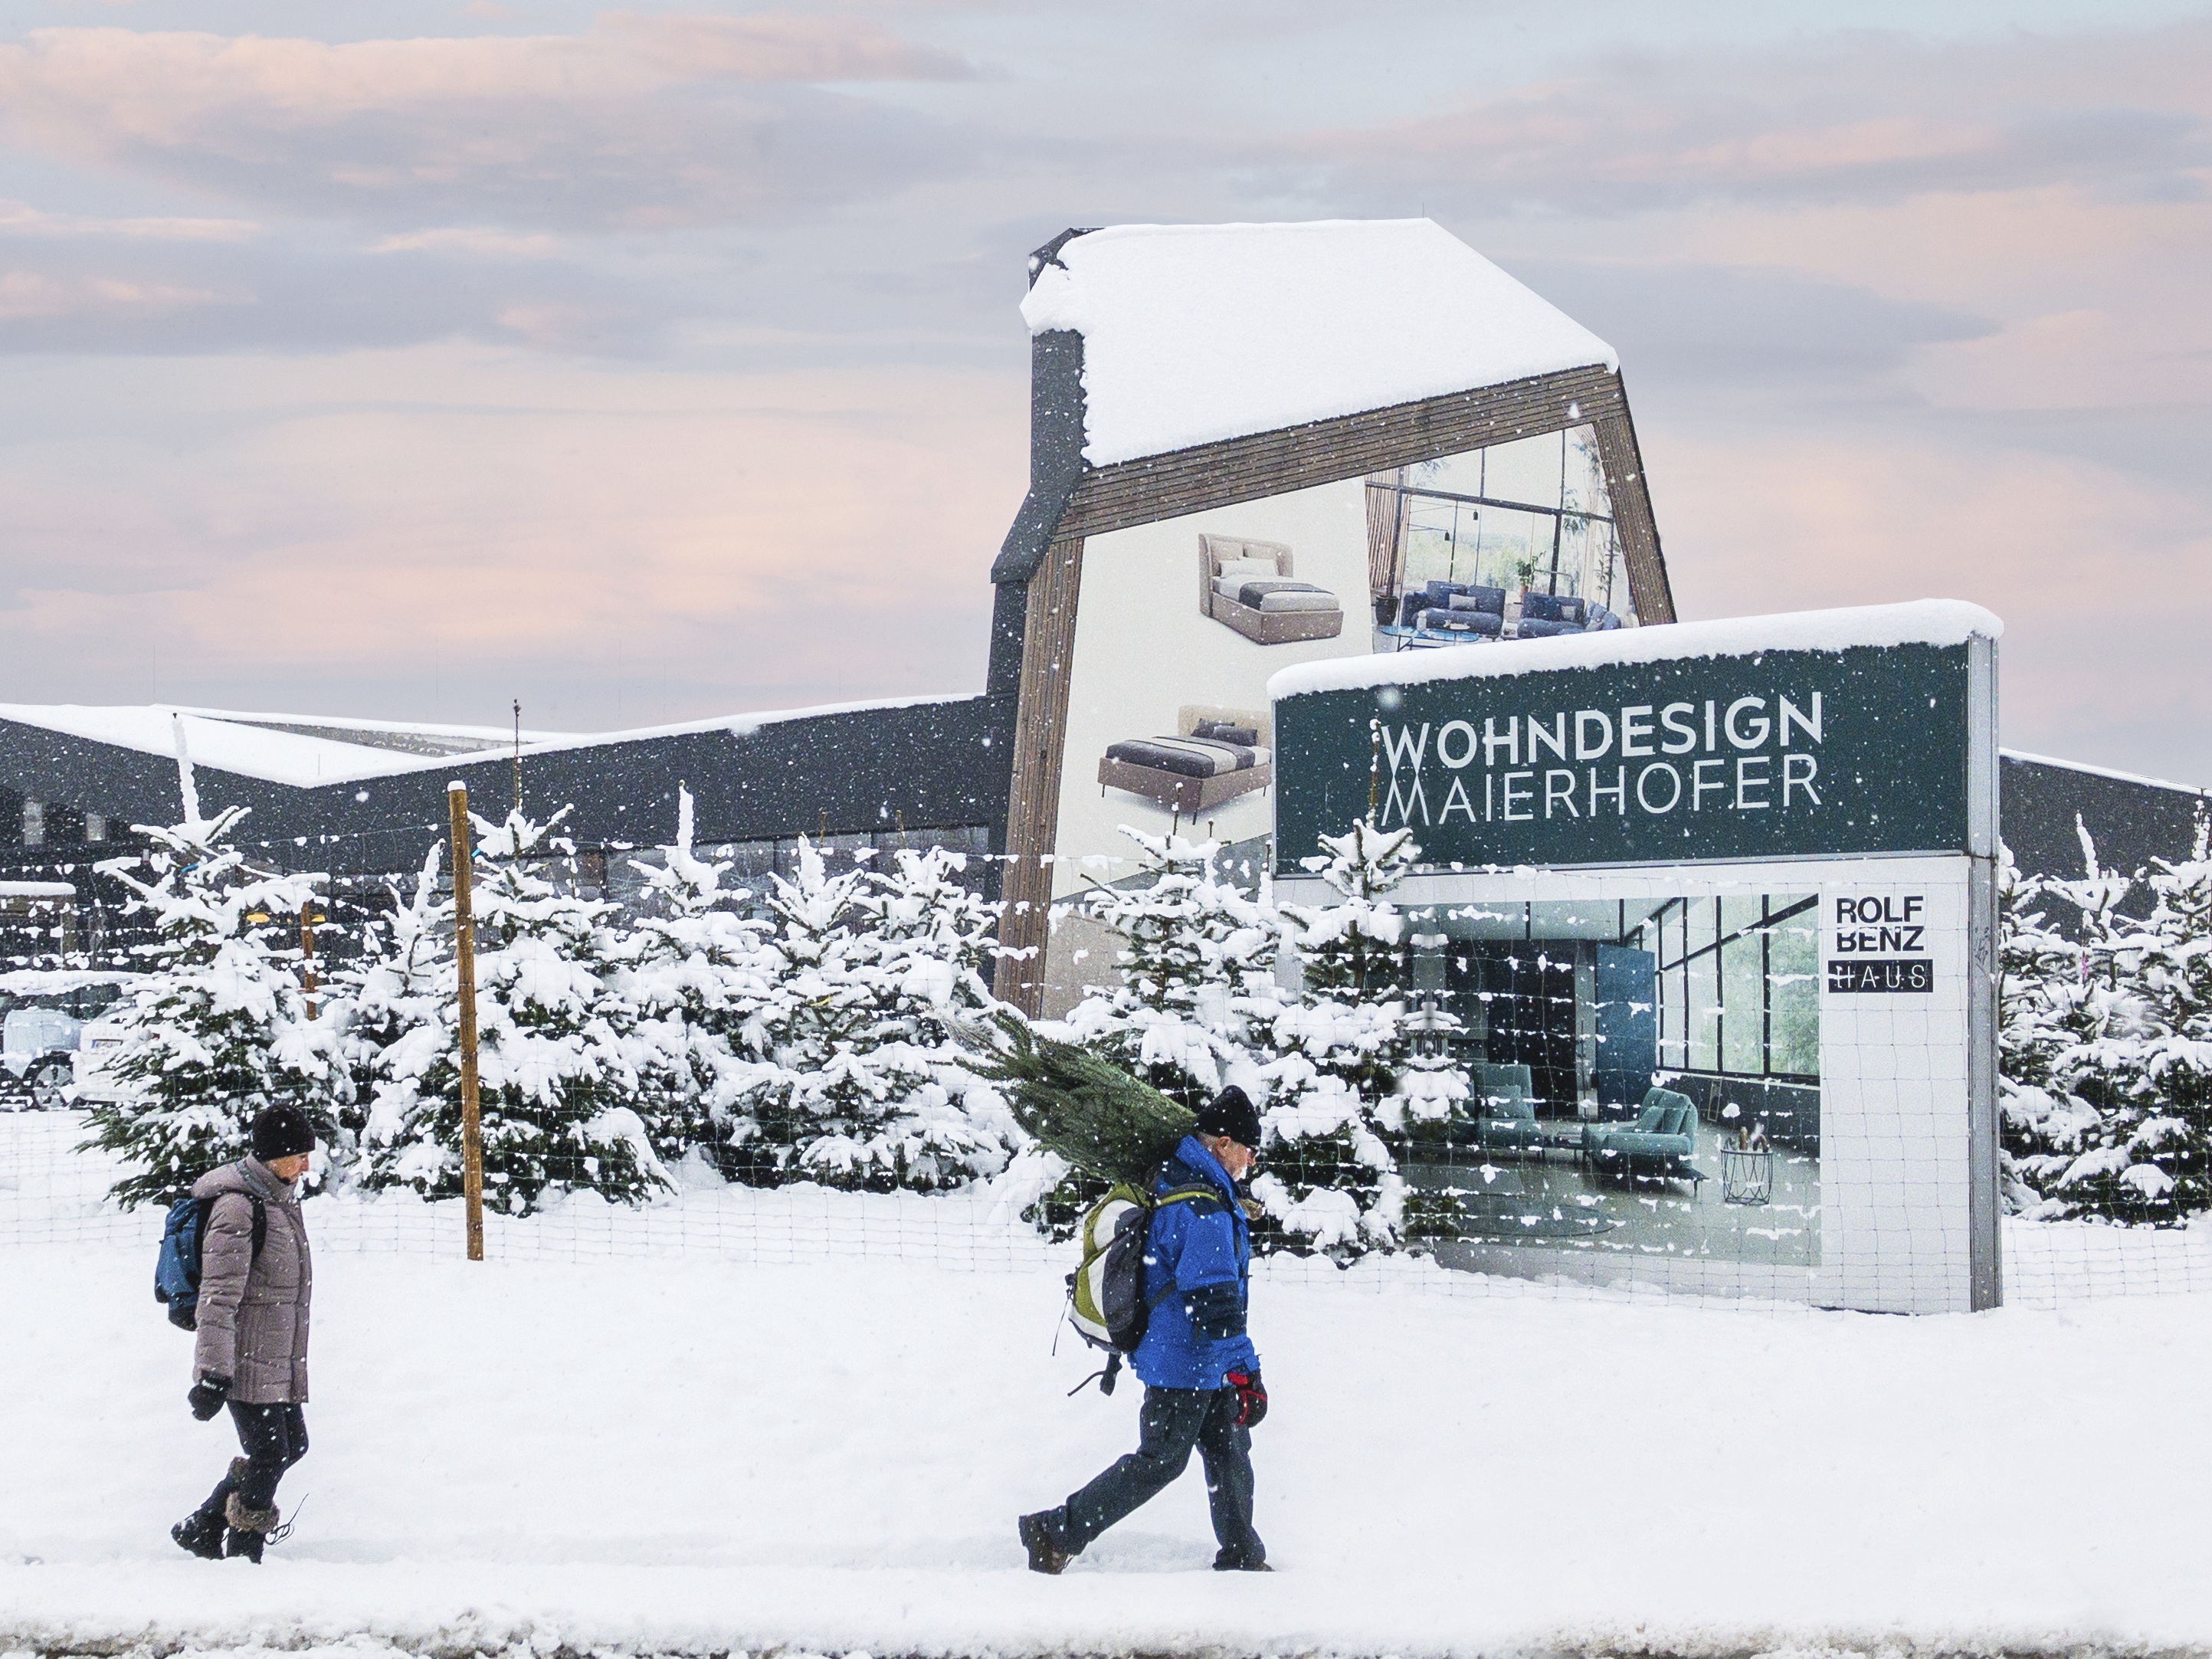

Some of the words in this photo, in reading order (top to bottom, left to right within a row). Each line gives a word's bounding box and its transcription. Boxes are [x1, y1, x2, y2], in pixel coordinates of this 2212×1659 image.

[1381, 691, 1822, 775] WOHNDESIGN
[1381, 753, 1822, 827] MAIERHOFER
[1836, 896, 1924, 923] ROLF
[1836, 926, 1925, 952] BENZ
[1836, 964, 1925, 989] HAUS
